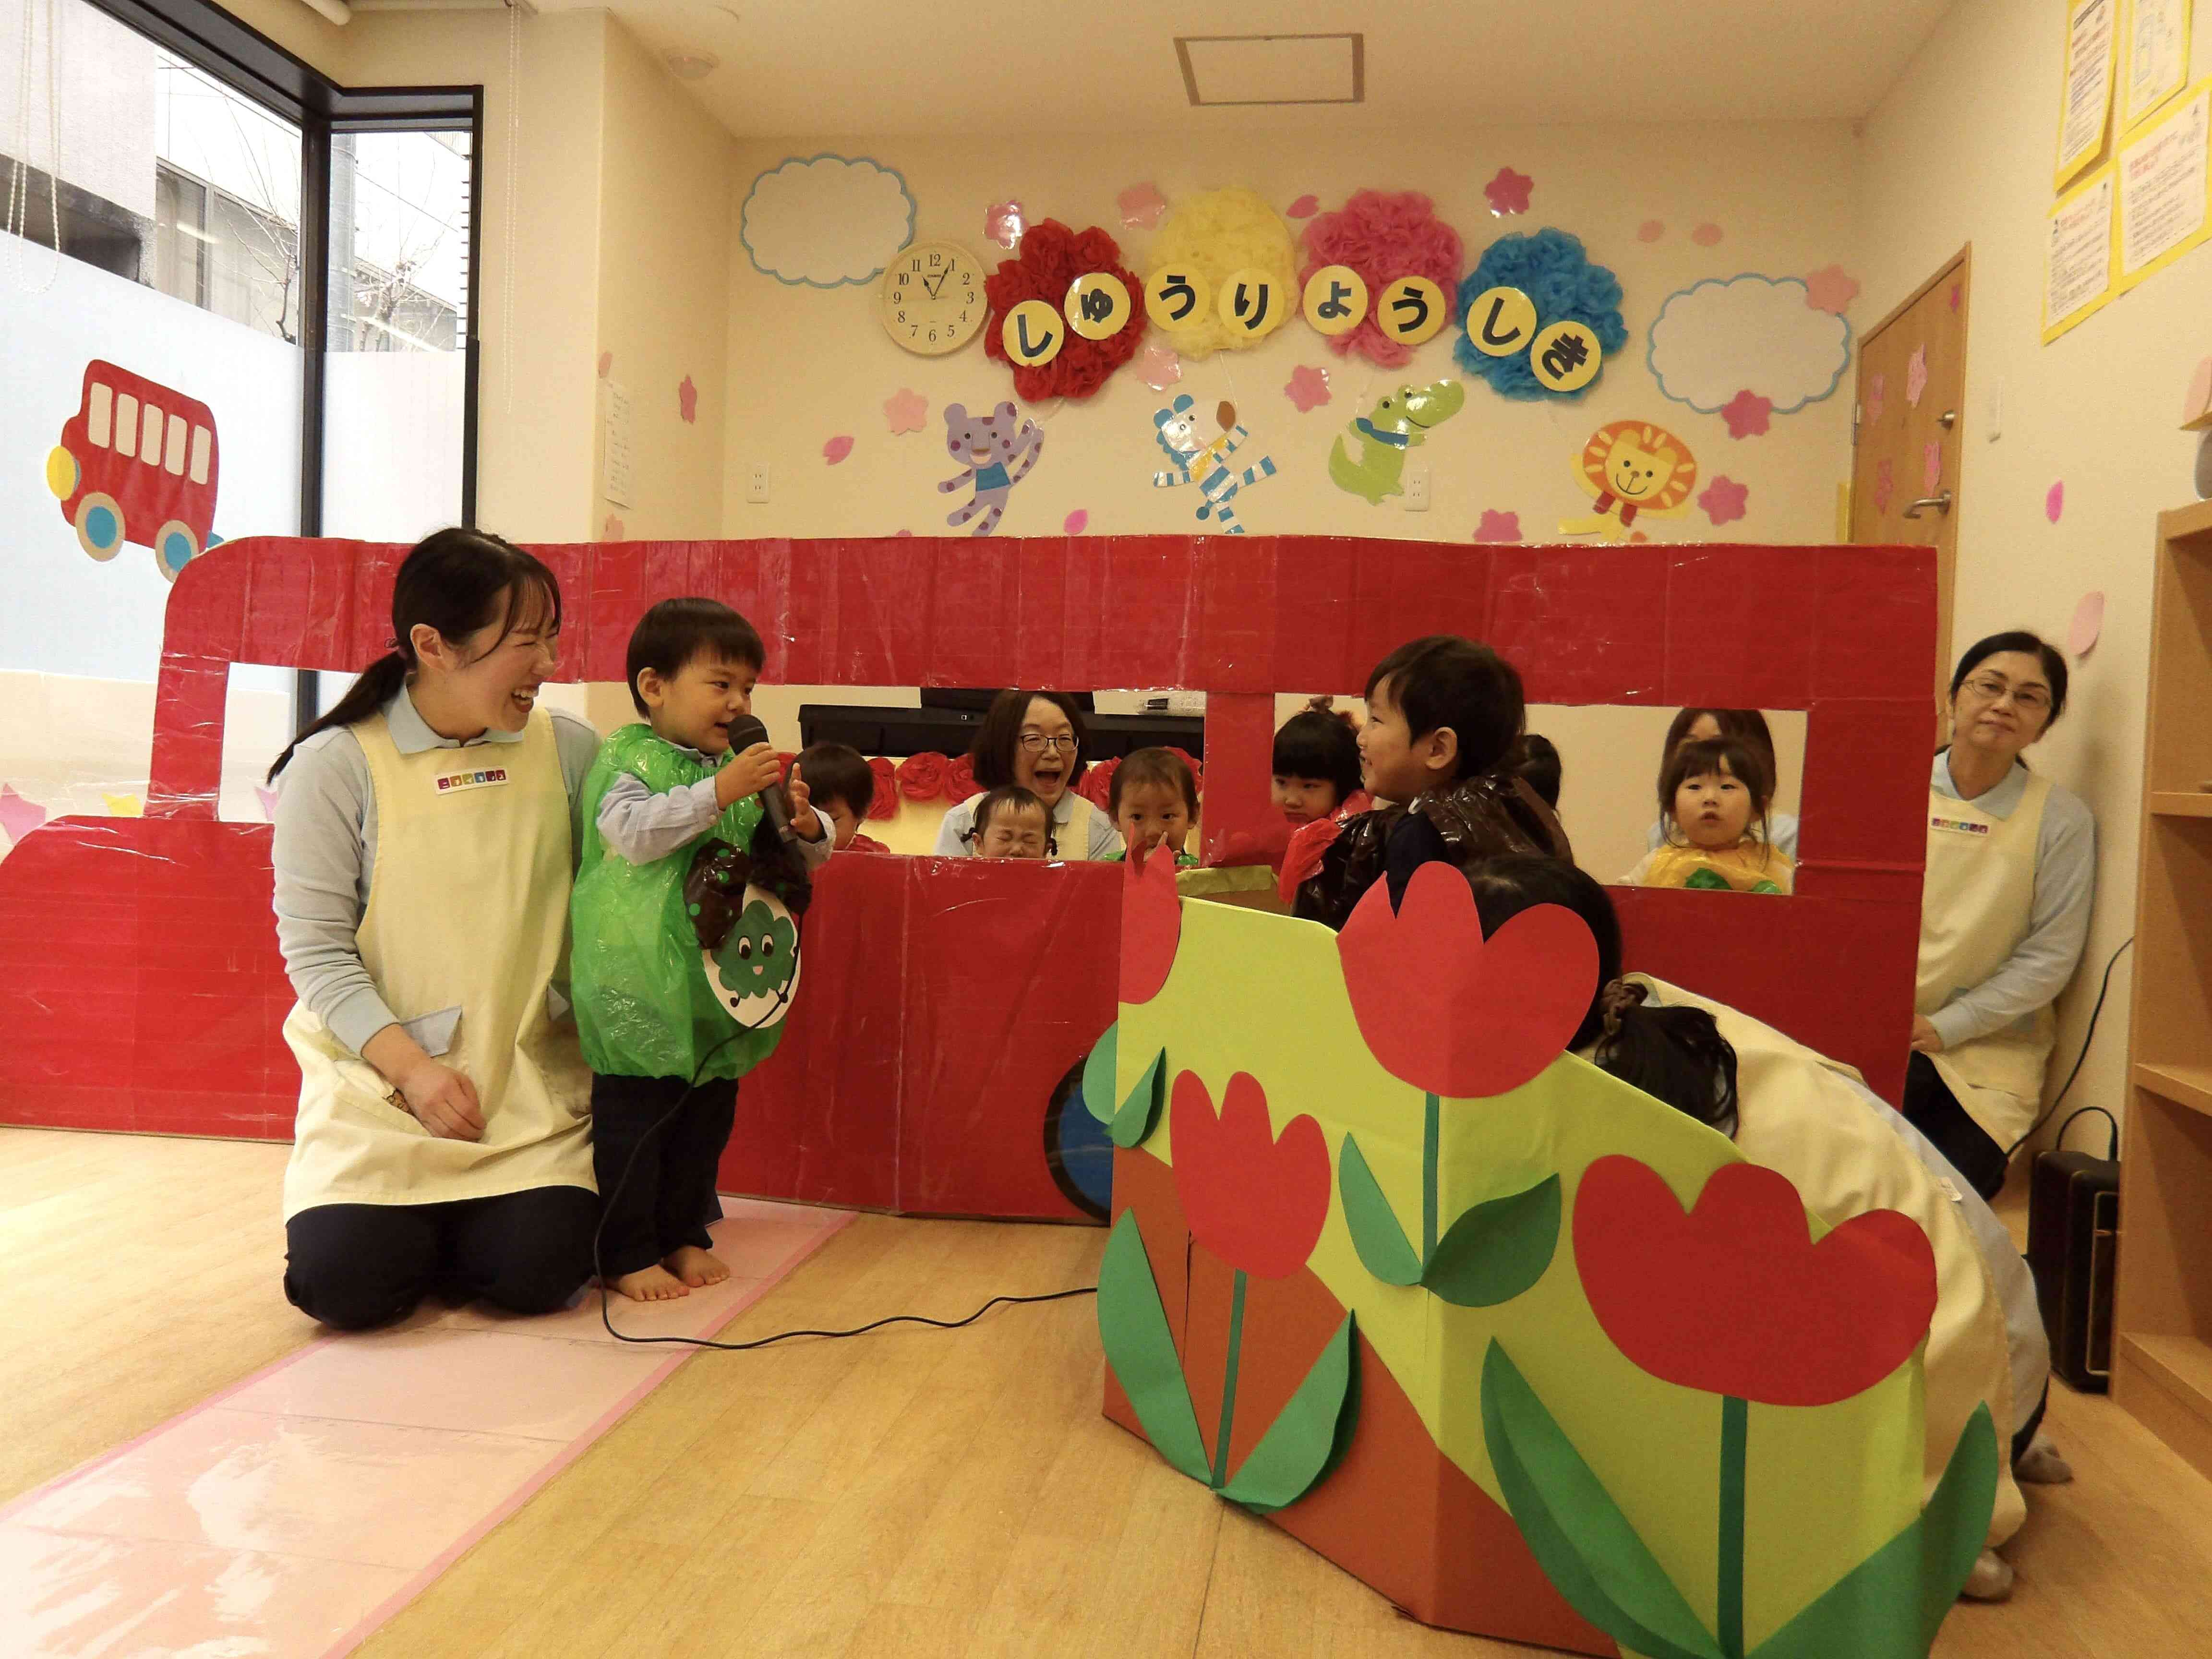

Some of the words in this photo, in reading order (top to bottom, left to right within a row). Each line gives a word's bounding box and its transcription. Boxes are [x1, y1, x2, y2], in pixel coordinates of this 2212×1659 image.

[913, 259, 920, 272] 11
[929, 254, 940, 266] 12
[899, 273, 909, 285] 10
[962, 272, 970, 285] 2
[893, 292, 901, 304] 9
[966, 292, 974, 304] 3
[898, 311, 905, 323] 8
[959, 310, 967, 322] 4
[911, 325, 918, 337] 7
[947, 325, 955, 337] 5
[1017, 275, 1587, 381] しゅうりょうしき
[929, 329, 936, 342] 6
